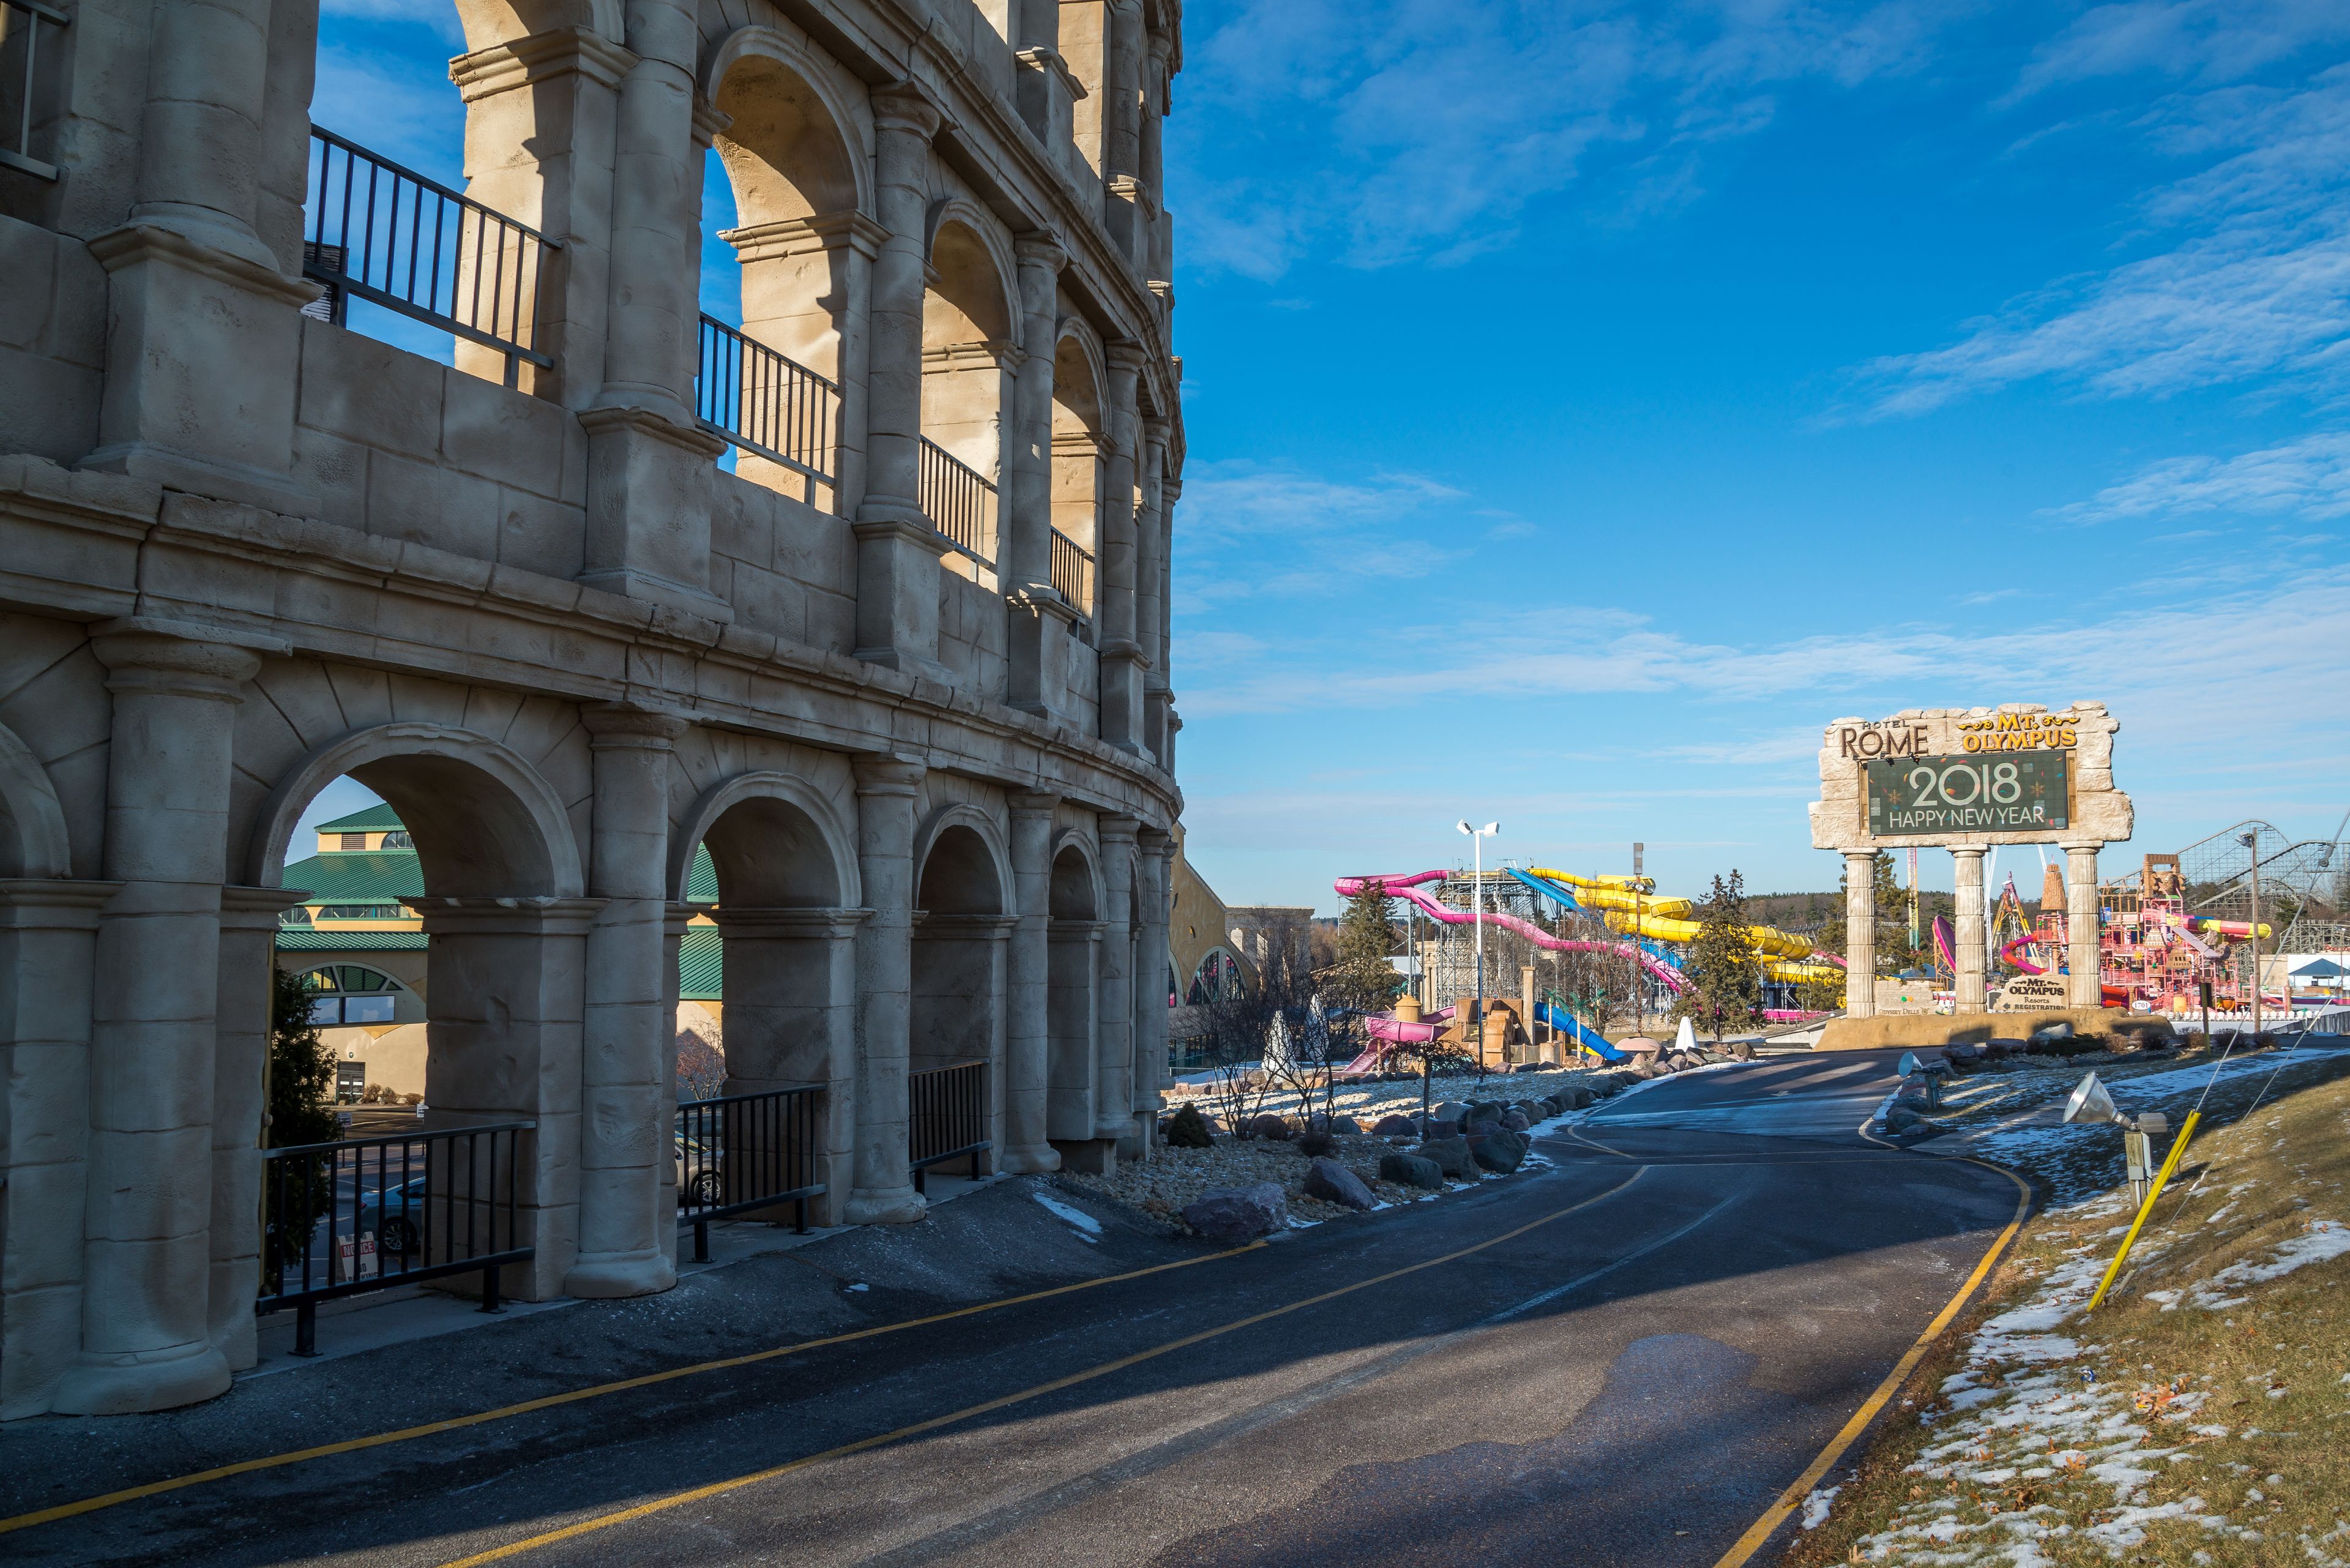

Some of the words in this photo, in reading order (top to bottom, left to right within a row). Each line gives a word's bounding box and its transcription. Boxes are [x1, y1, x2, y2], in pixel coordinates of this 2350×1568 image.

[1862, 720, 1911, 730] HOTEL
[1996, 714, 2040, 731] MT.
[1841, 725, 1930, 758] ROME
[1963, 728, 2078, 753] OLYMPUS
[1909, 763, 2021, 807] 2018
[1889, 810, 1947, 829] HAPPY
[1950, 807, 1994, 826] NEW
[1996, 805, 2045, 825] YEAR
[2009, 986, 2065, 996] OLYMPUS
[2026, 978, 2046, 987] MT.
[343, 1242, 374, 1256] NOICE
